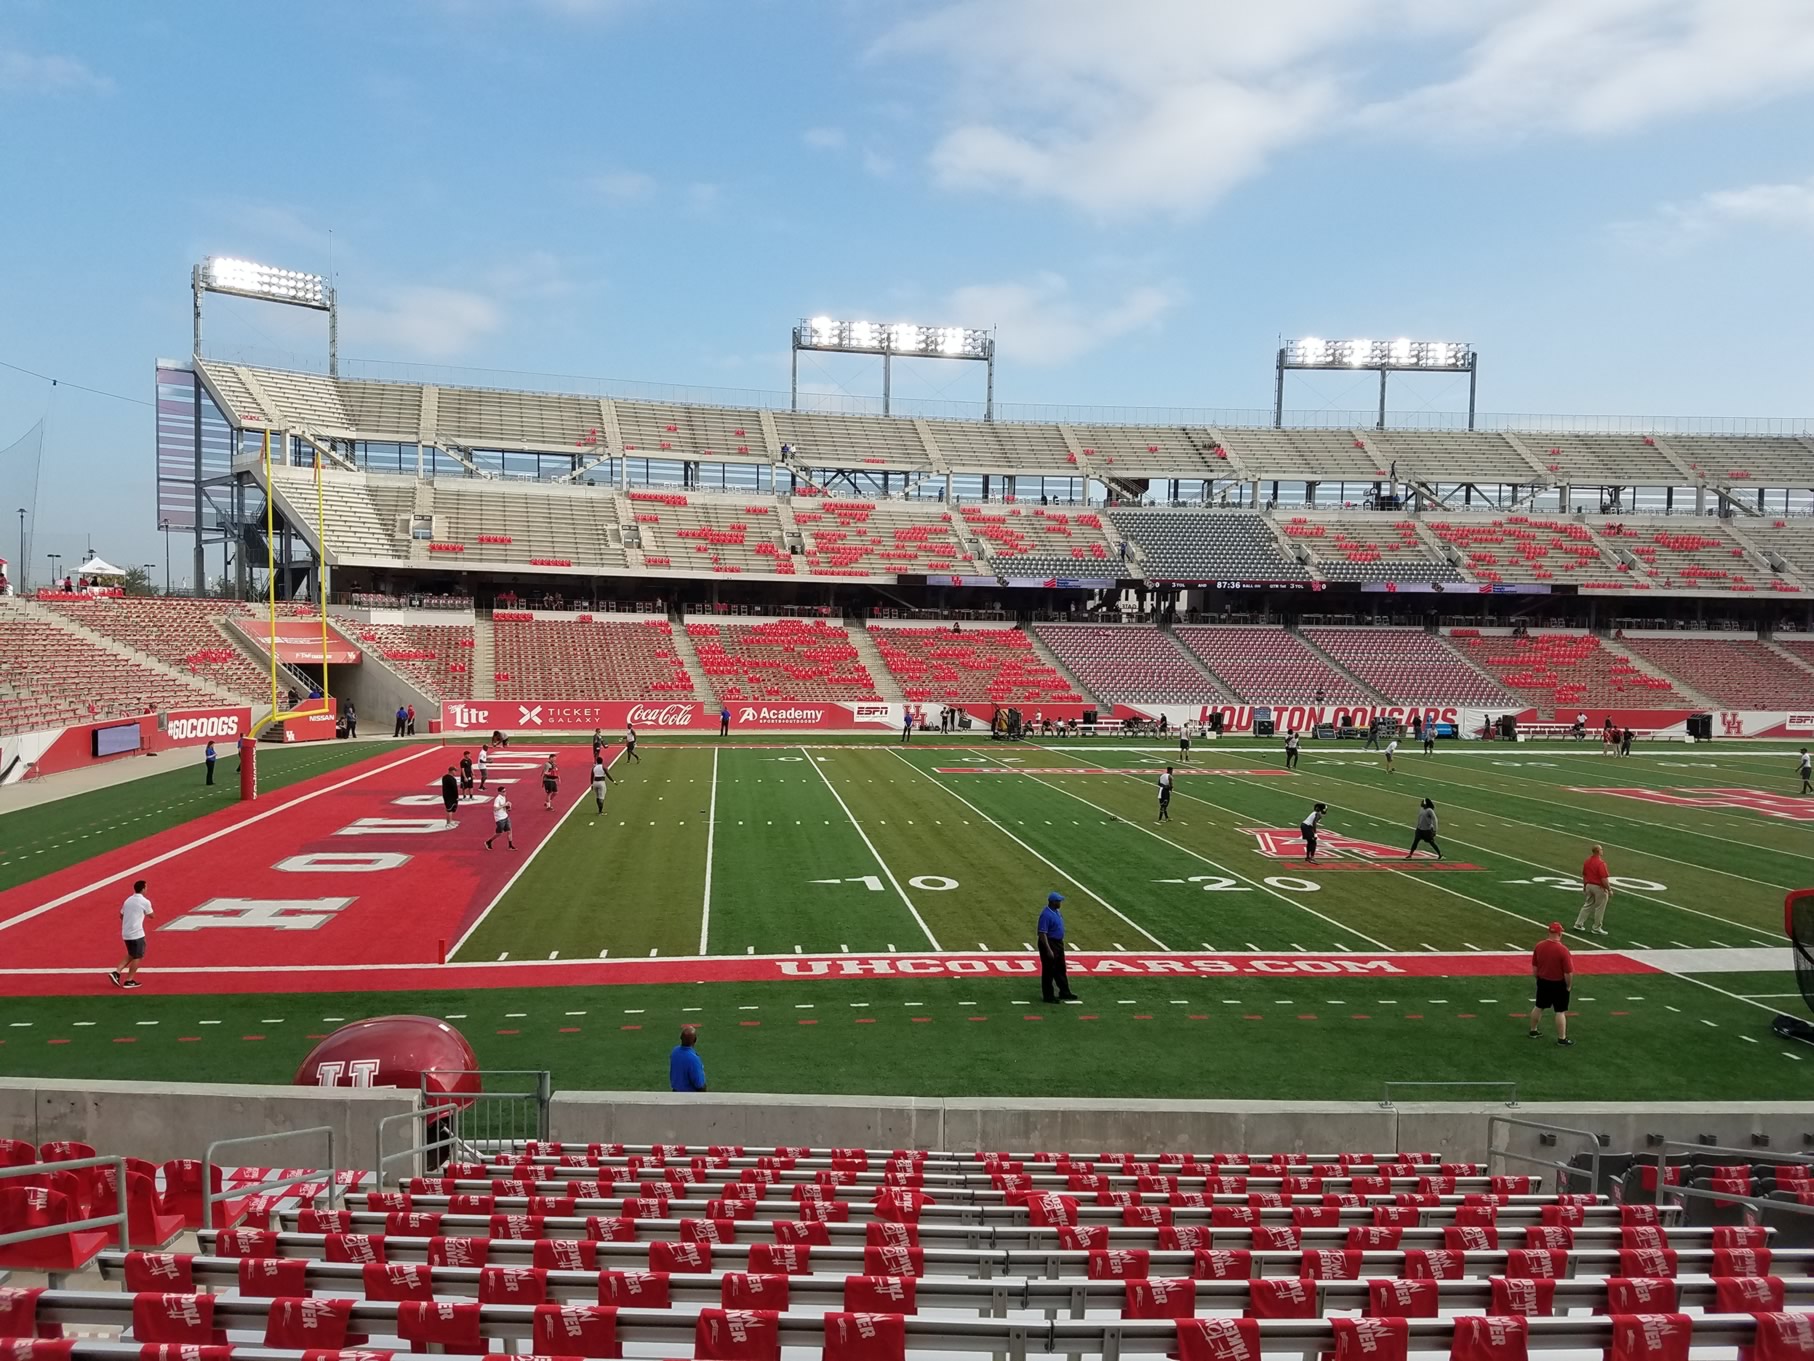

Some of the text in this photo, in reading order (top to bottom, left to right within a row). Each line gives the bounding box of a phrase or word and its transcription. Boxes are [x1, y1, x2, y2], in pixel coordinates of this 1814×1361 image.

[1217, 581, 1241, 589] 87:36
[309, 714, 335, 722] NISSAN
[454, 707, 489, 728] Lite
[548, 708, 601, 716] TICKET
[626, 703, 696, 726] Coca-Cola
[759, 706, 822, 724] Academy
[856, 706, 888, 716] ESPN
[1199, 705, 1326, 733] HOUTON
[1789, 715, 1814, 725] ESP
[168, 715, 239, 741] #GOCOOGS
